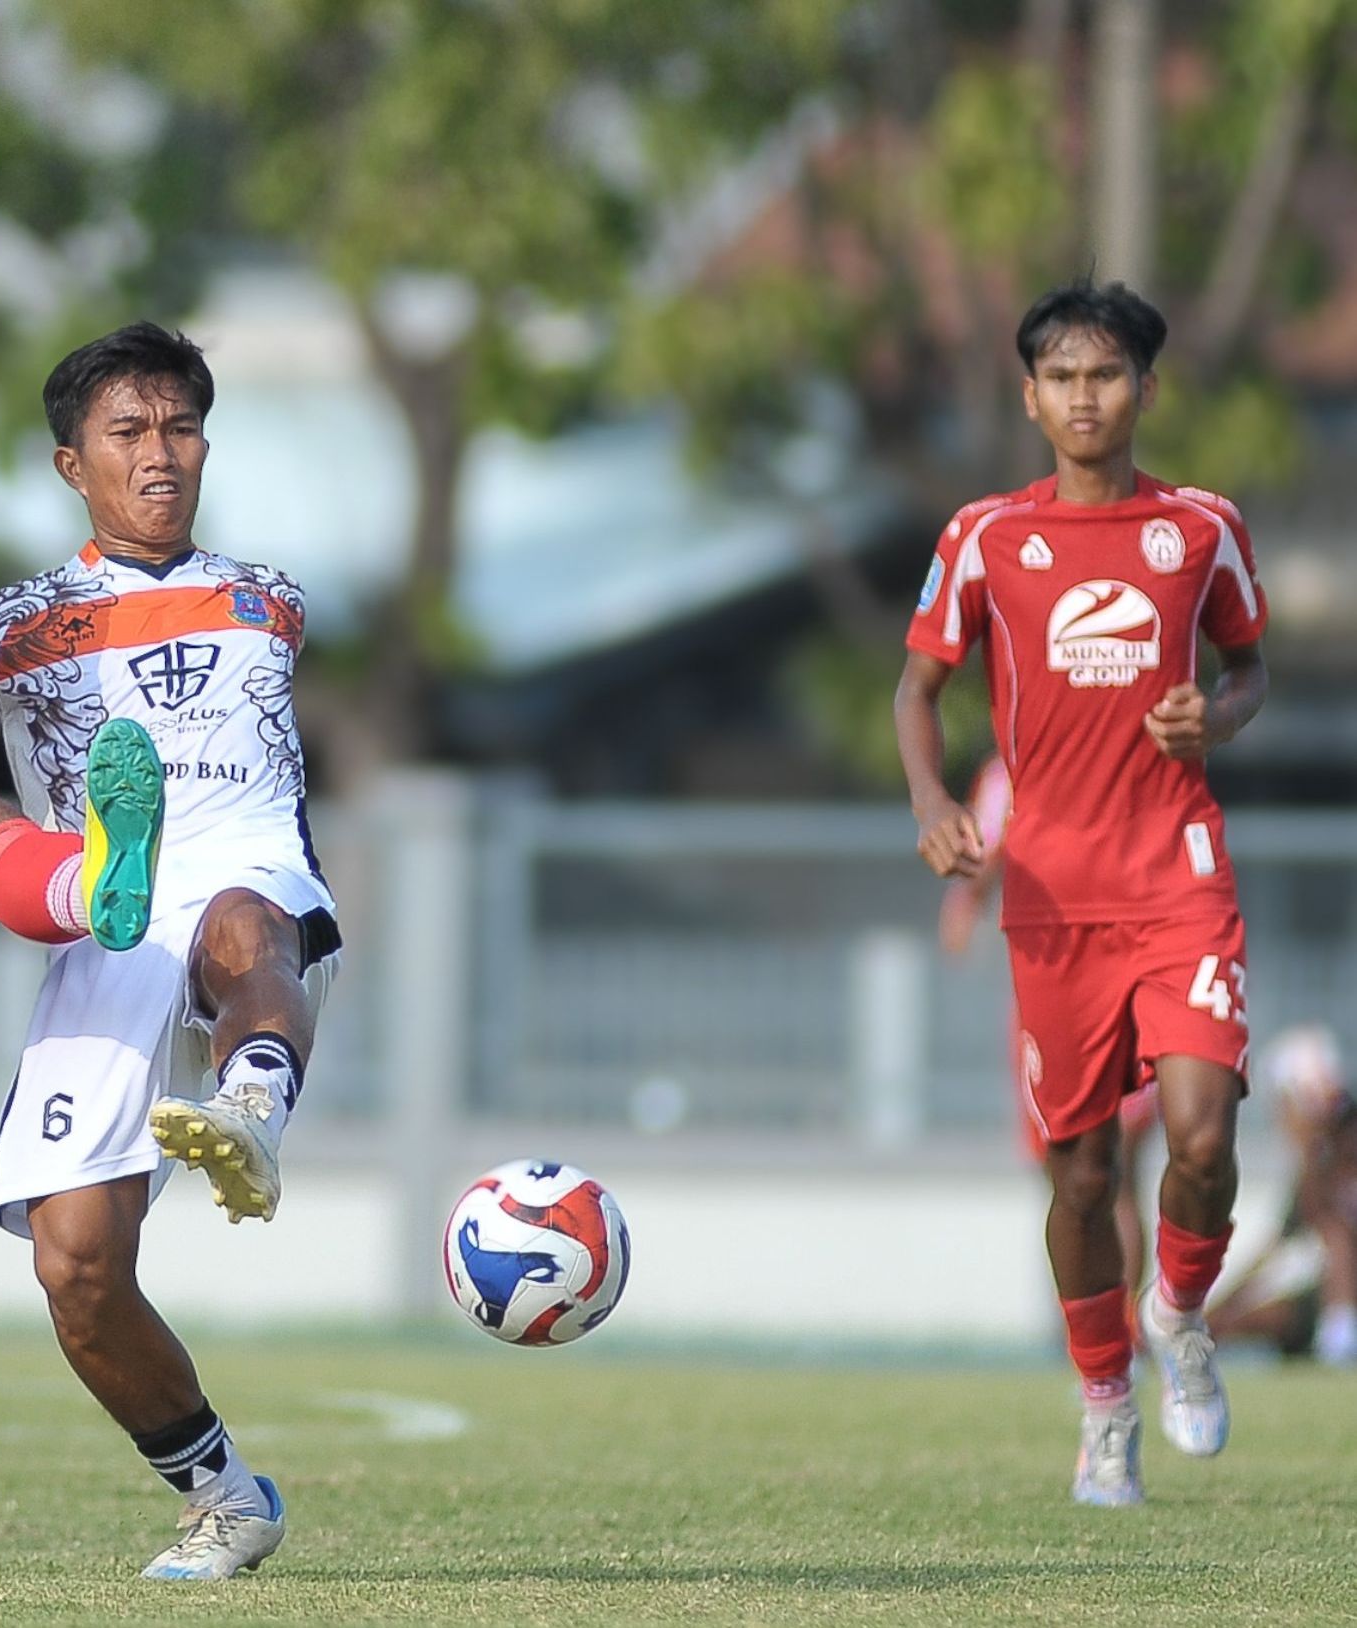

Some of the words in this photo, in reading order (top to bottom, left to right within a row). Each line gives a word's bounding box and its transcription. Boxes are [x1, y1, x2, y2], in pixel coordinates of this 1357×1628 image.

[1062, 643, 1148, 660] MUNCUL
[162, 762, 190, 781] PD
[197, 761, 248, 783] BALI
[42, 1092, 74, 1142] 6
